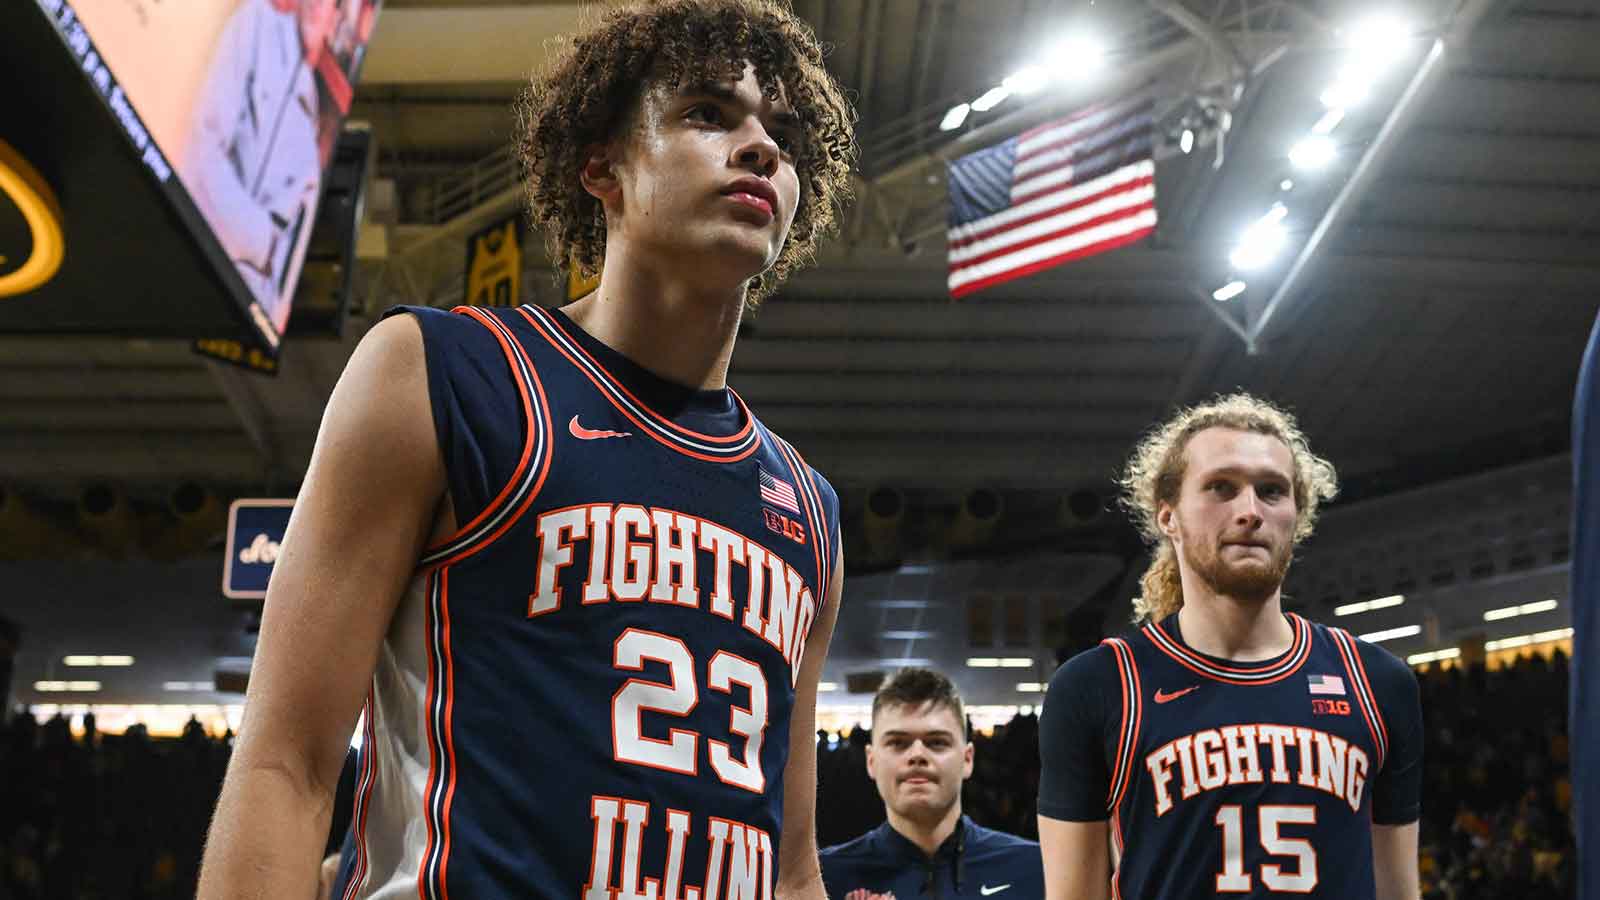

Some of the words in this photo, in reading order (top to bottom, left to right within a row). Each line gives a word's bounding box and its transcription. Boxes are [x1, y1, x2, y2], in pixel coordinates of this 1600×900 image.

[527, 503, 816, 689] FIGHTING
[611, 627, 769, 794] 23
[1146, 723, 1369, 817] FIGHTING
[583, 794, 774, 900] ILLINI
[1215, 804, 1319, 893] 15
